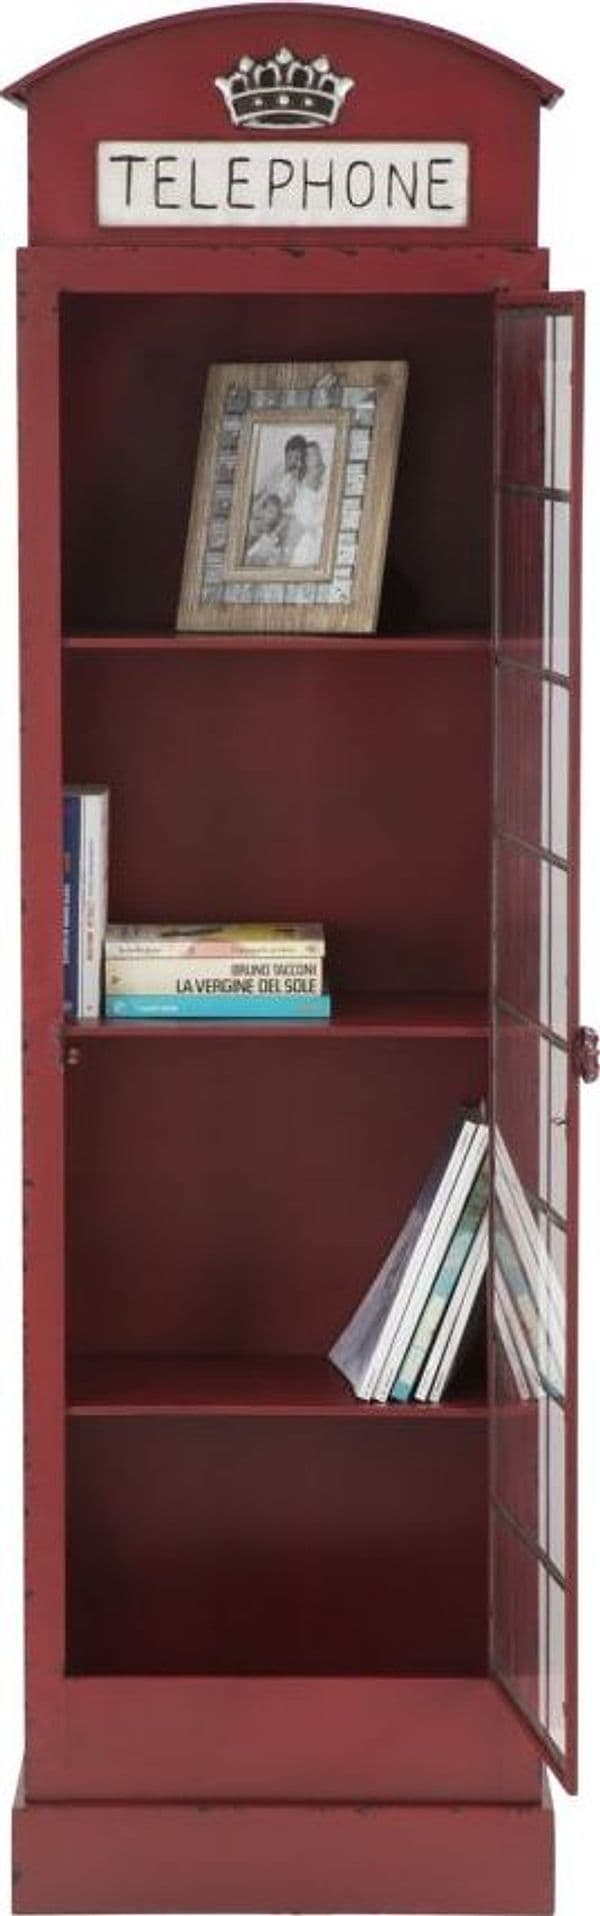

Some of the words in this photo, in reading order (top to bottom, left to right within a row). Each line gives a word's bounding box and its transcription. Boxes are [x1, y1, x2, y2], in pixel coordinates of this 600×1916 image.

[109, 154, 454, 209] TELEPHONE
[176, 978, 193, 993] LA
[194, 978, 255, 993] VERGINE
[258, 978, 284, 993] DEL
[285, 978, 317, 993] SOLE
